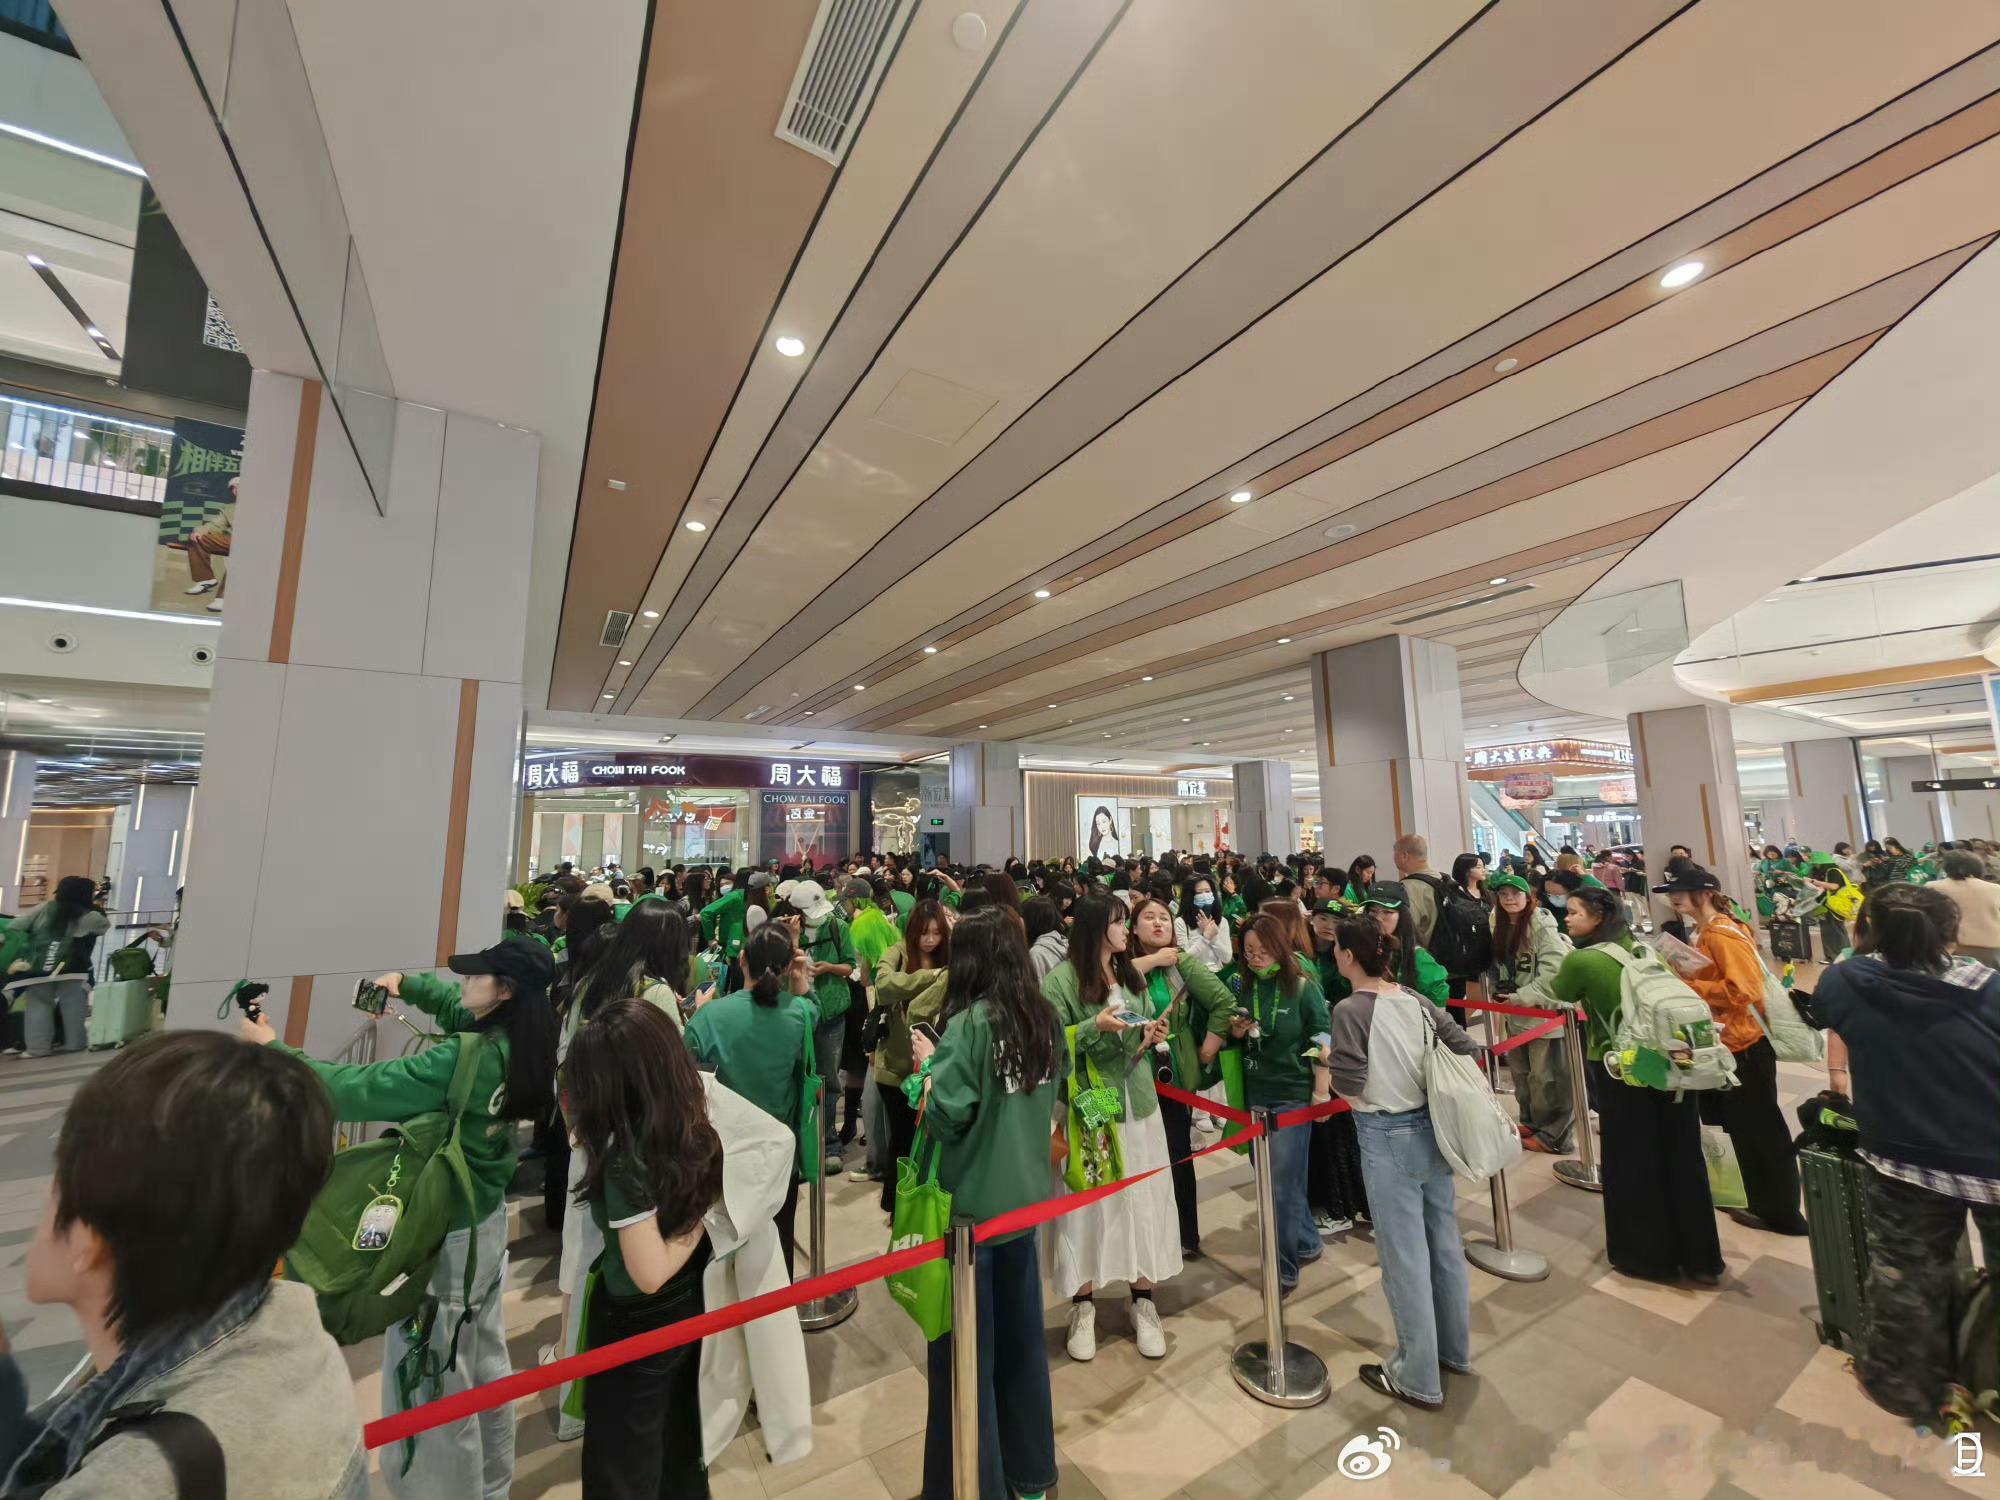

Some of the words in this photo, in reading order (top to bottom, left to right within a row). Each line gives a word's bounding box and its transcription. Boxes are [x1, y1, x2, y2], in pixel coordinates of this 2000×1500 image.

[528, 761, 579, 786] 周大福
[592, 765, 625, 775] CHOW
[626, 765, 646, 775] TAI
[651, 765, 686, 775] FOOK
[769, 763, 842, 787] 周大福
[763, 794, 797, 804] CHOW
[801, 795, 815, 804] TAI
[818, 795, 846, 804] FOOK
